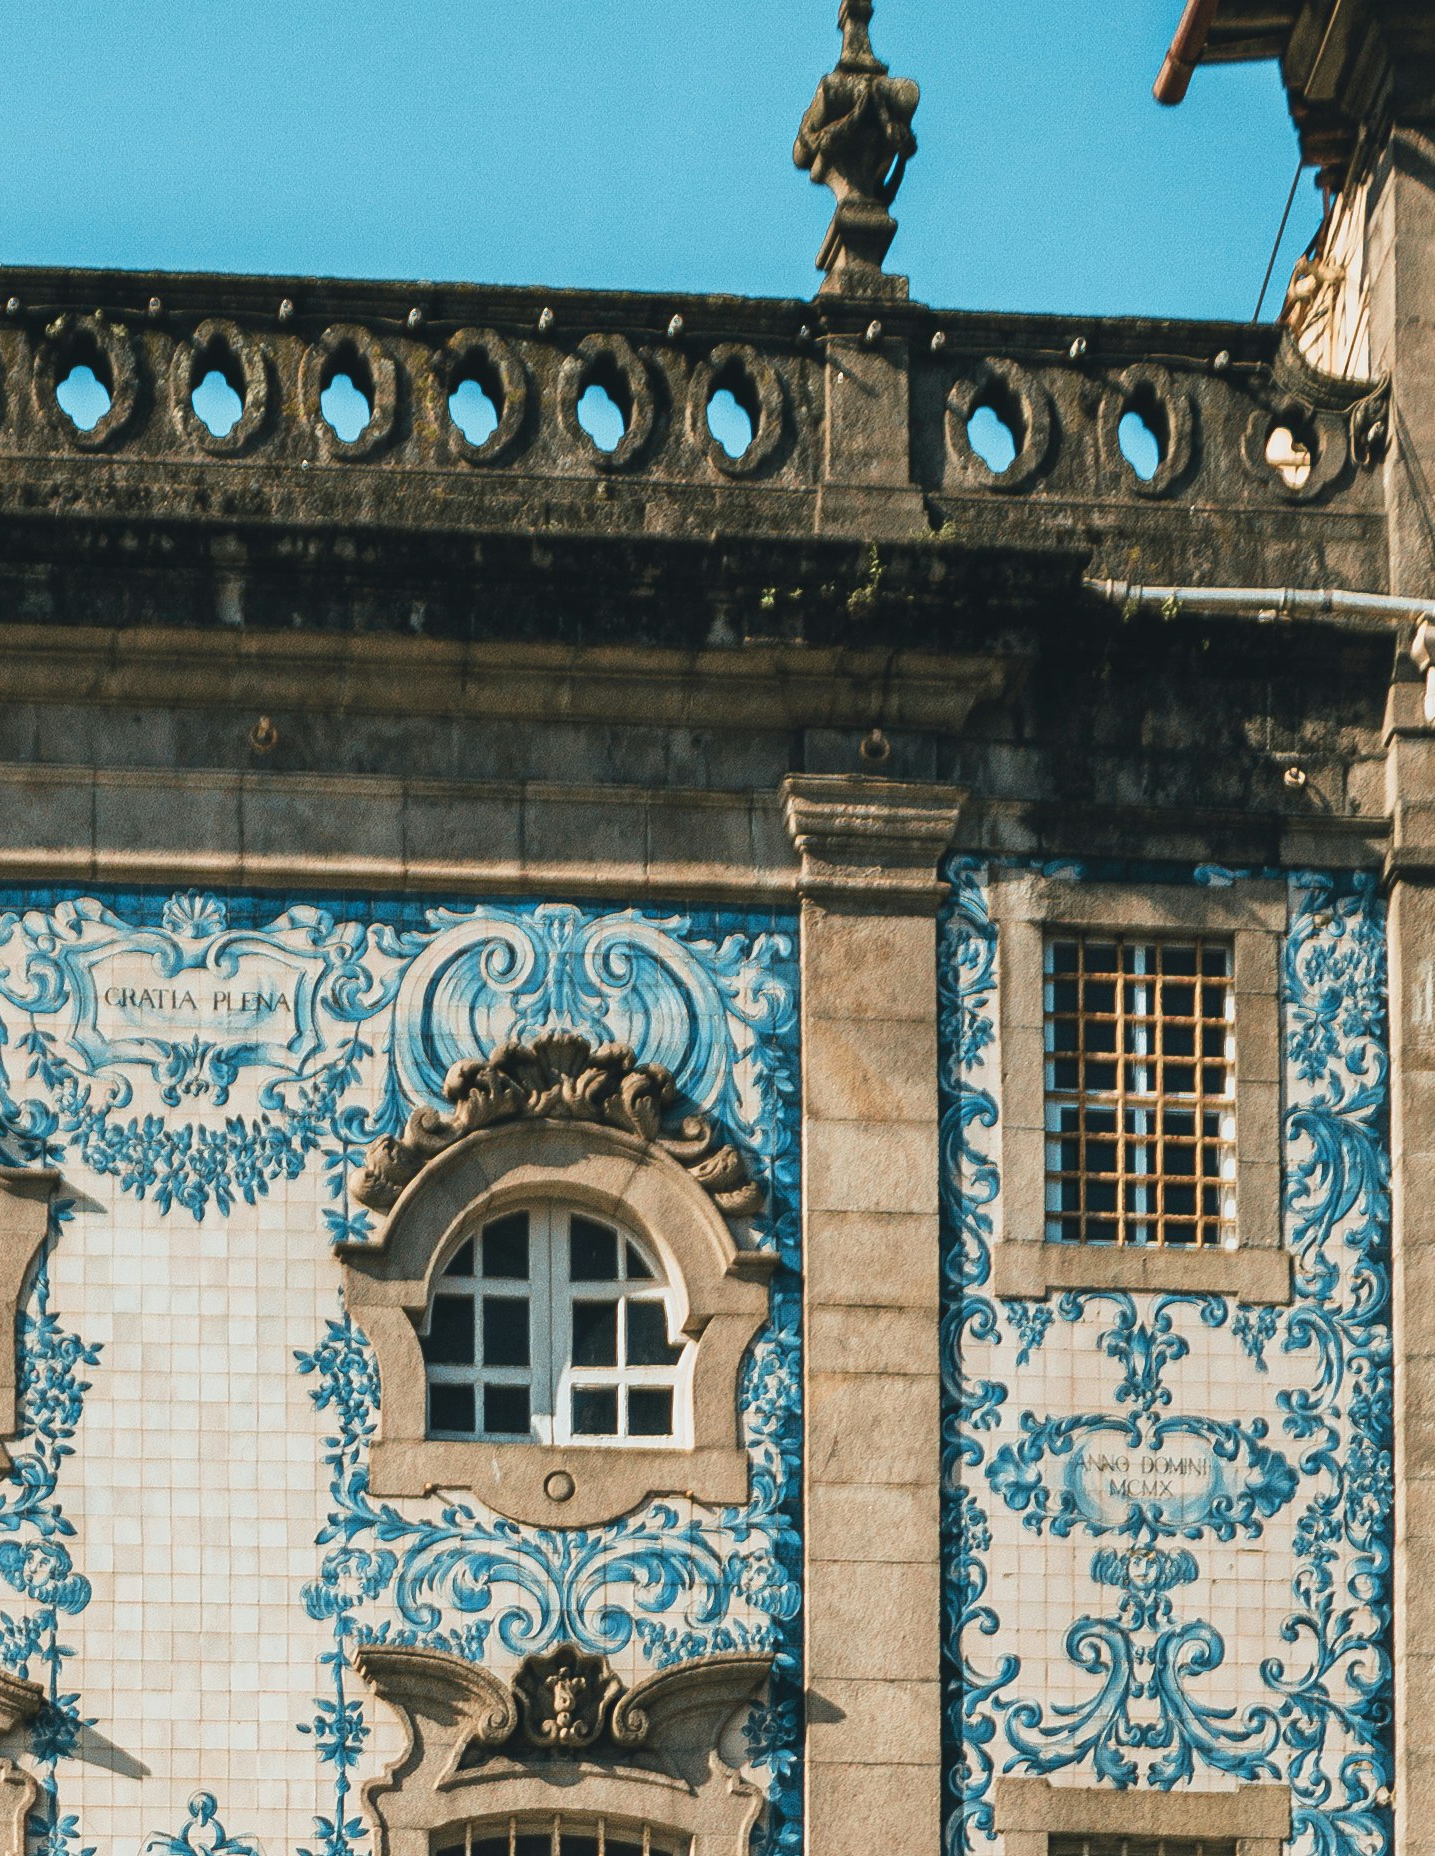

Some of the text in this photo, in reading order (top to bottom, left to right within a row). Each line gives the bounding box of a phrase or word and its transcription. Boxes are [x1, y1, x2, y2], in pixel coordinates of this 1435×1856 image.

[104, 986, 291, 1013] GRATIA PLENA
[1077, 1453, 1208, 1476] ANNO DOMINI
[1109, 1479, 1173, 1497] MCMX
